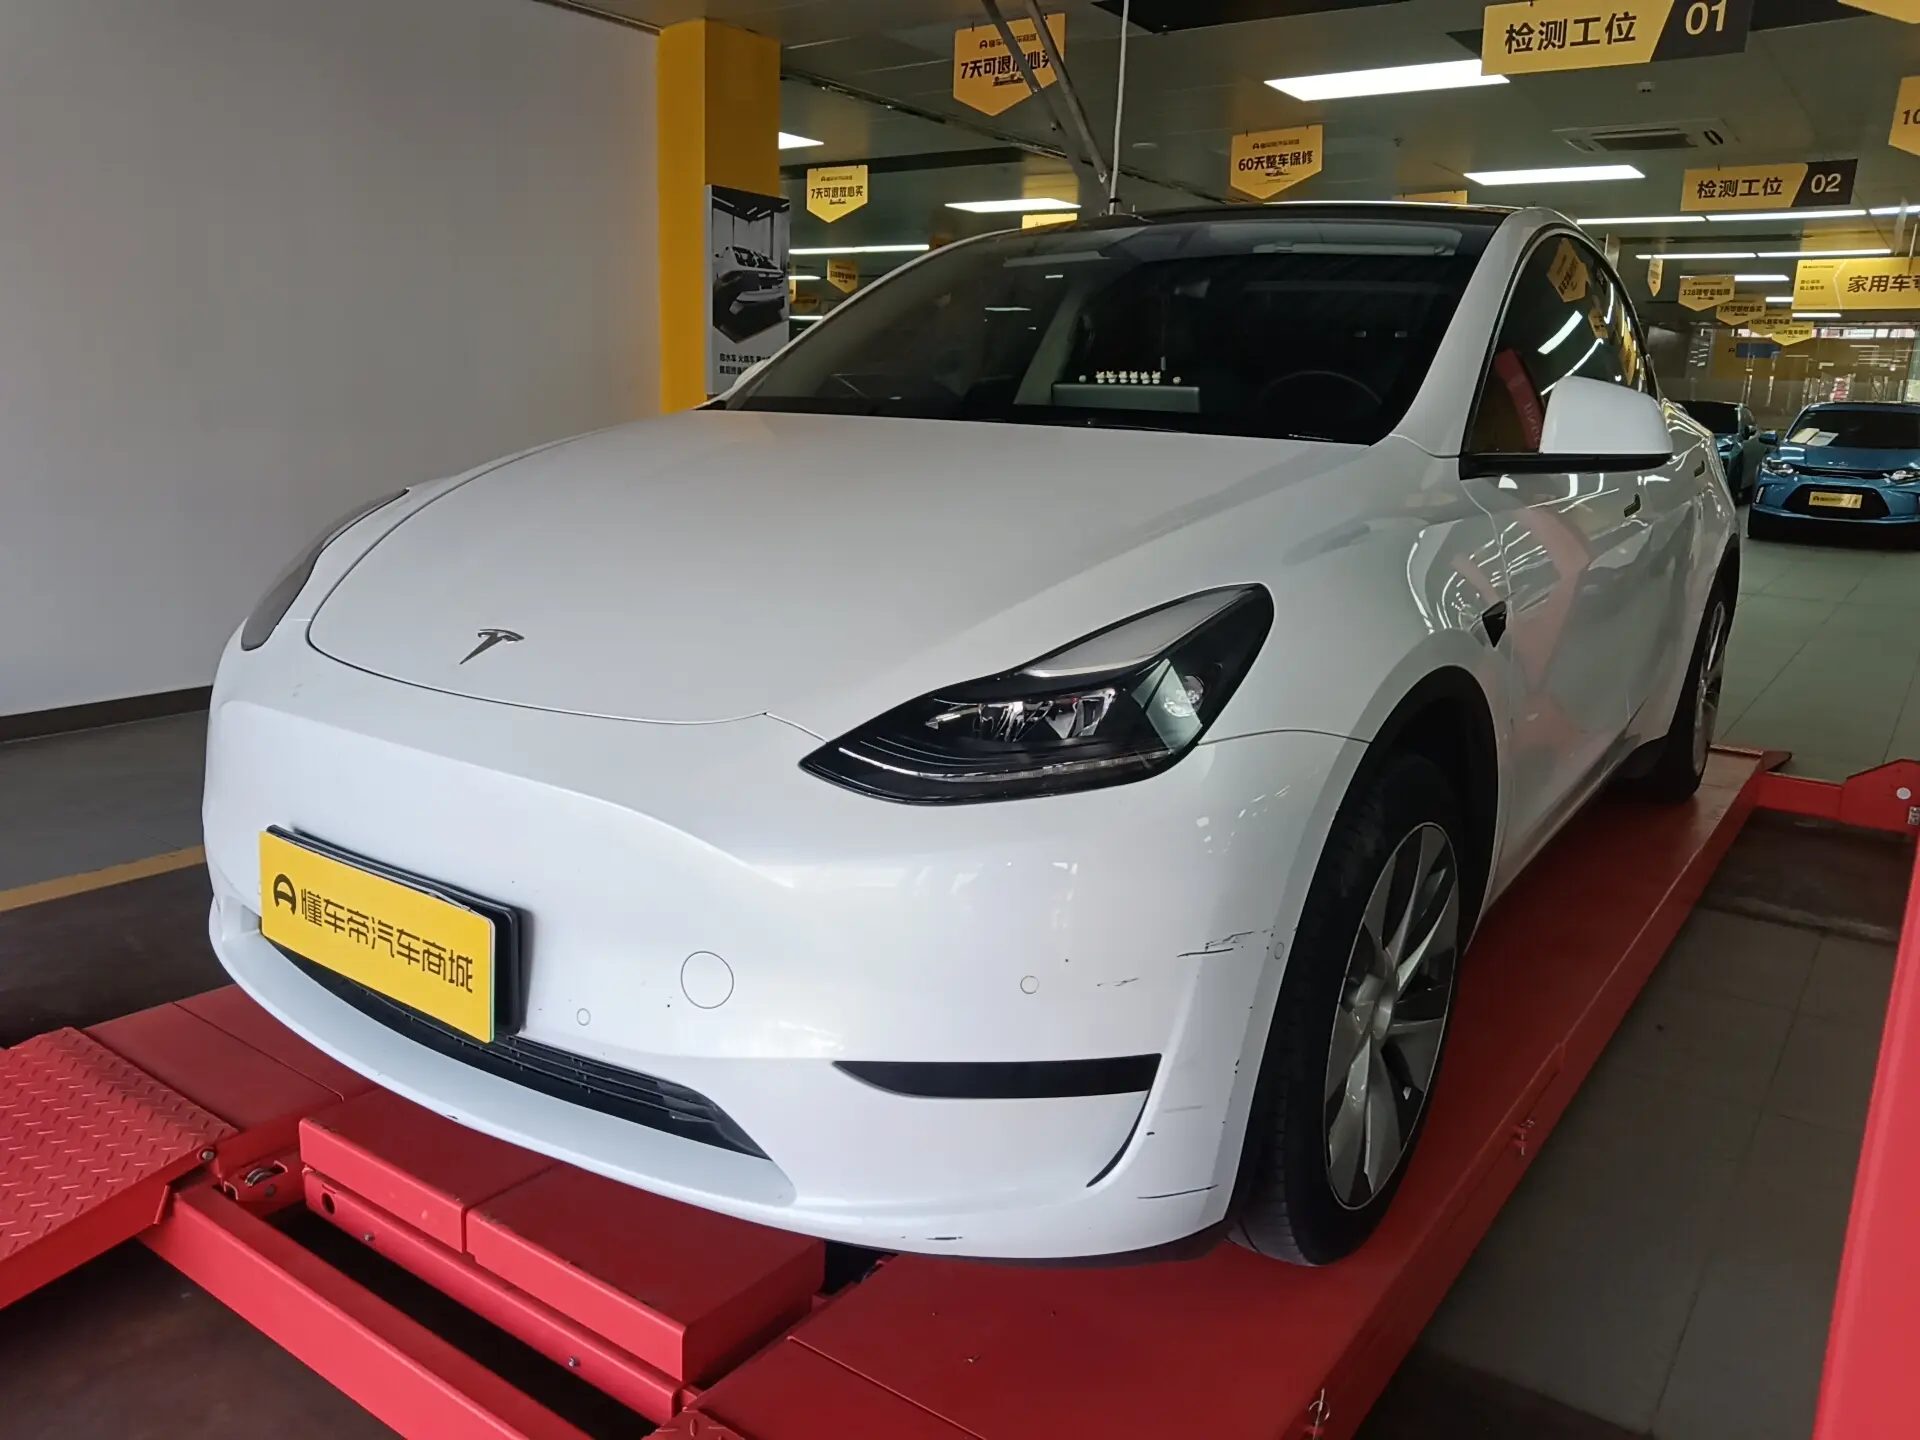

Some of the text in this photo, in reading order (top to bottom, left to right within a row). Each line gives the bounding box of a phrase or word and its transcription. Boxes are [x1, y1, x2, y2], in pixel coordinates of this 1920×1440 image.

[1685, 0, 1728, 35] 01
[1505, 11, 1637, 54] 检测工位
[961, 50, 1050, 79] 7天可退心
[1238, 150, 1314, 171] 60天整车保修
[811, 185, 864, 199] 7天可退放心买
[1697, 177, 1783, 199] 检测工位
[1811, 173, 1842, 194] 02
[301, 887, 473, 993] 懂车帝汽车商城
